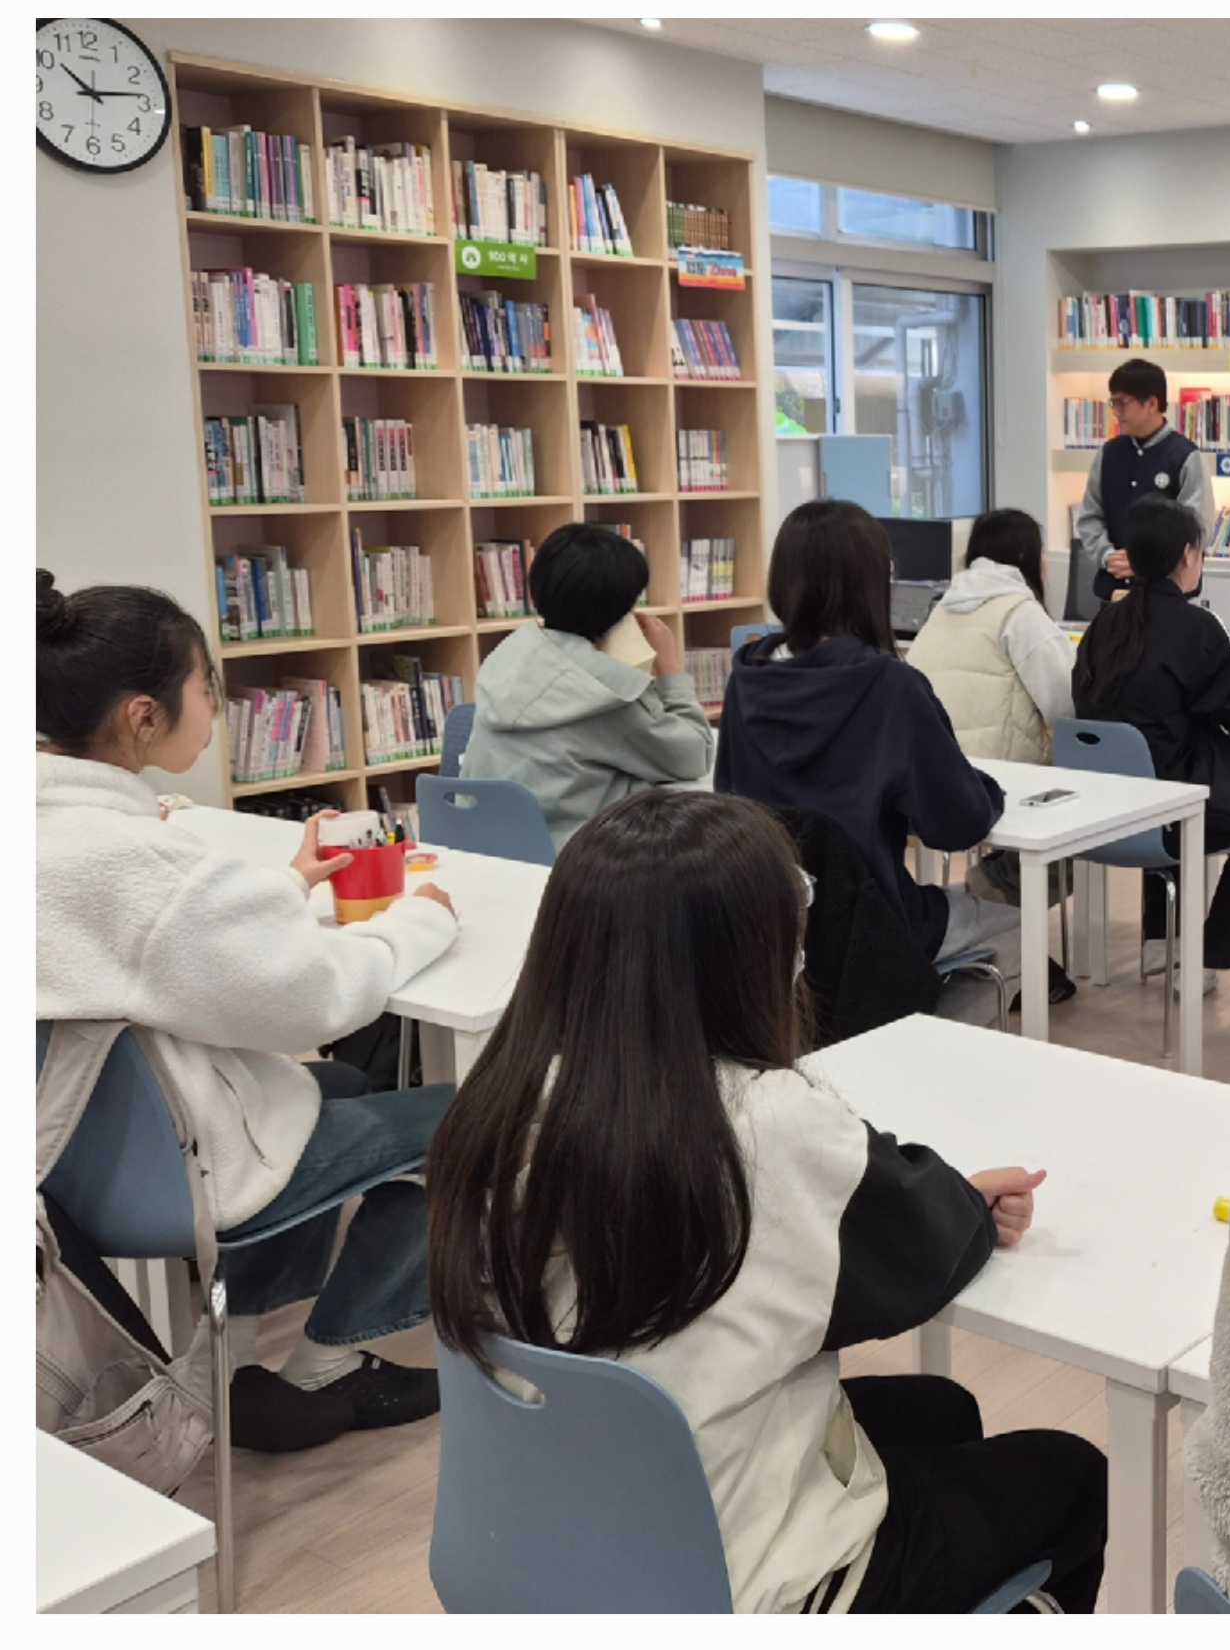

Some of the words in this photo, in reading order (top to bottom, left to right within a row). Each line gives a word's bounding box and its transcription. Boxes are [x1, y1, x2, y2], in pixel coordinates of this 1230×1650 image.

[53, 33, 71, 53] 11
[77, 30, 98, 52] 12
[110, 45, 118, 63] 1
[127, 65, 141, 85] 2
[39, 101, 54, 121] 8
[137, 93, 151, 113] 3
[60, 123, 75, 143] 7
[127, 116, 142, 136] 4
[86, 136, 101, 156] 6
[111, 133, 126, 153] 5
